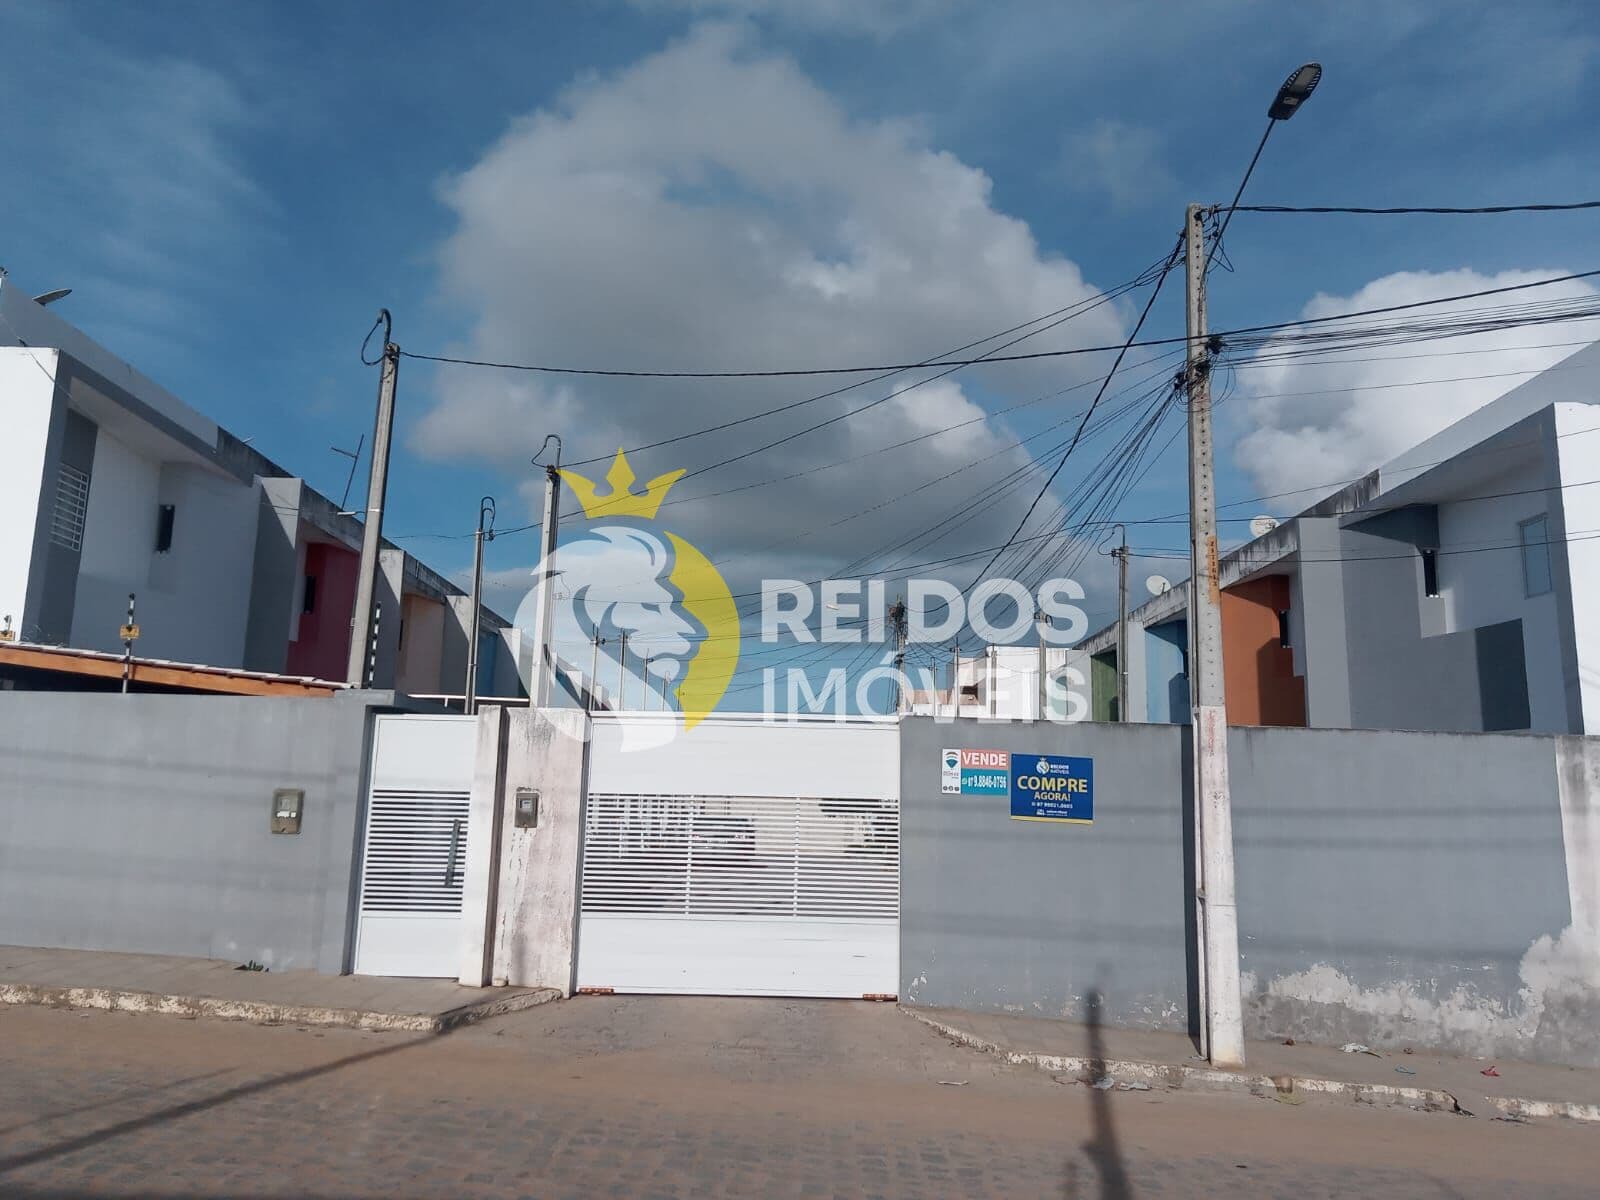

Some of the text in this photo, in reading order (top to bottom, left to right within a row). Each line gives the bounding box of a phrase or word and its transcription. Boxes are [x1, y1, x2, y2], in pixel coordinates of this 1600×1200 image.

[962, 751, 1007, 767] VENDE
[1017, 775, 1088, 793] COMPRE
[1033, 791, 1071, 802] AGORA!
